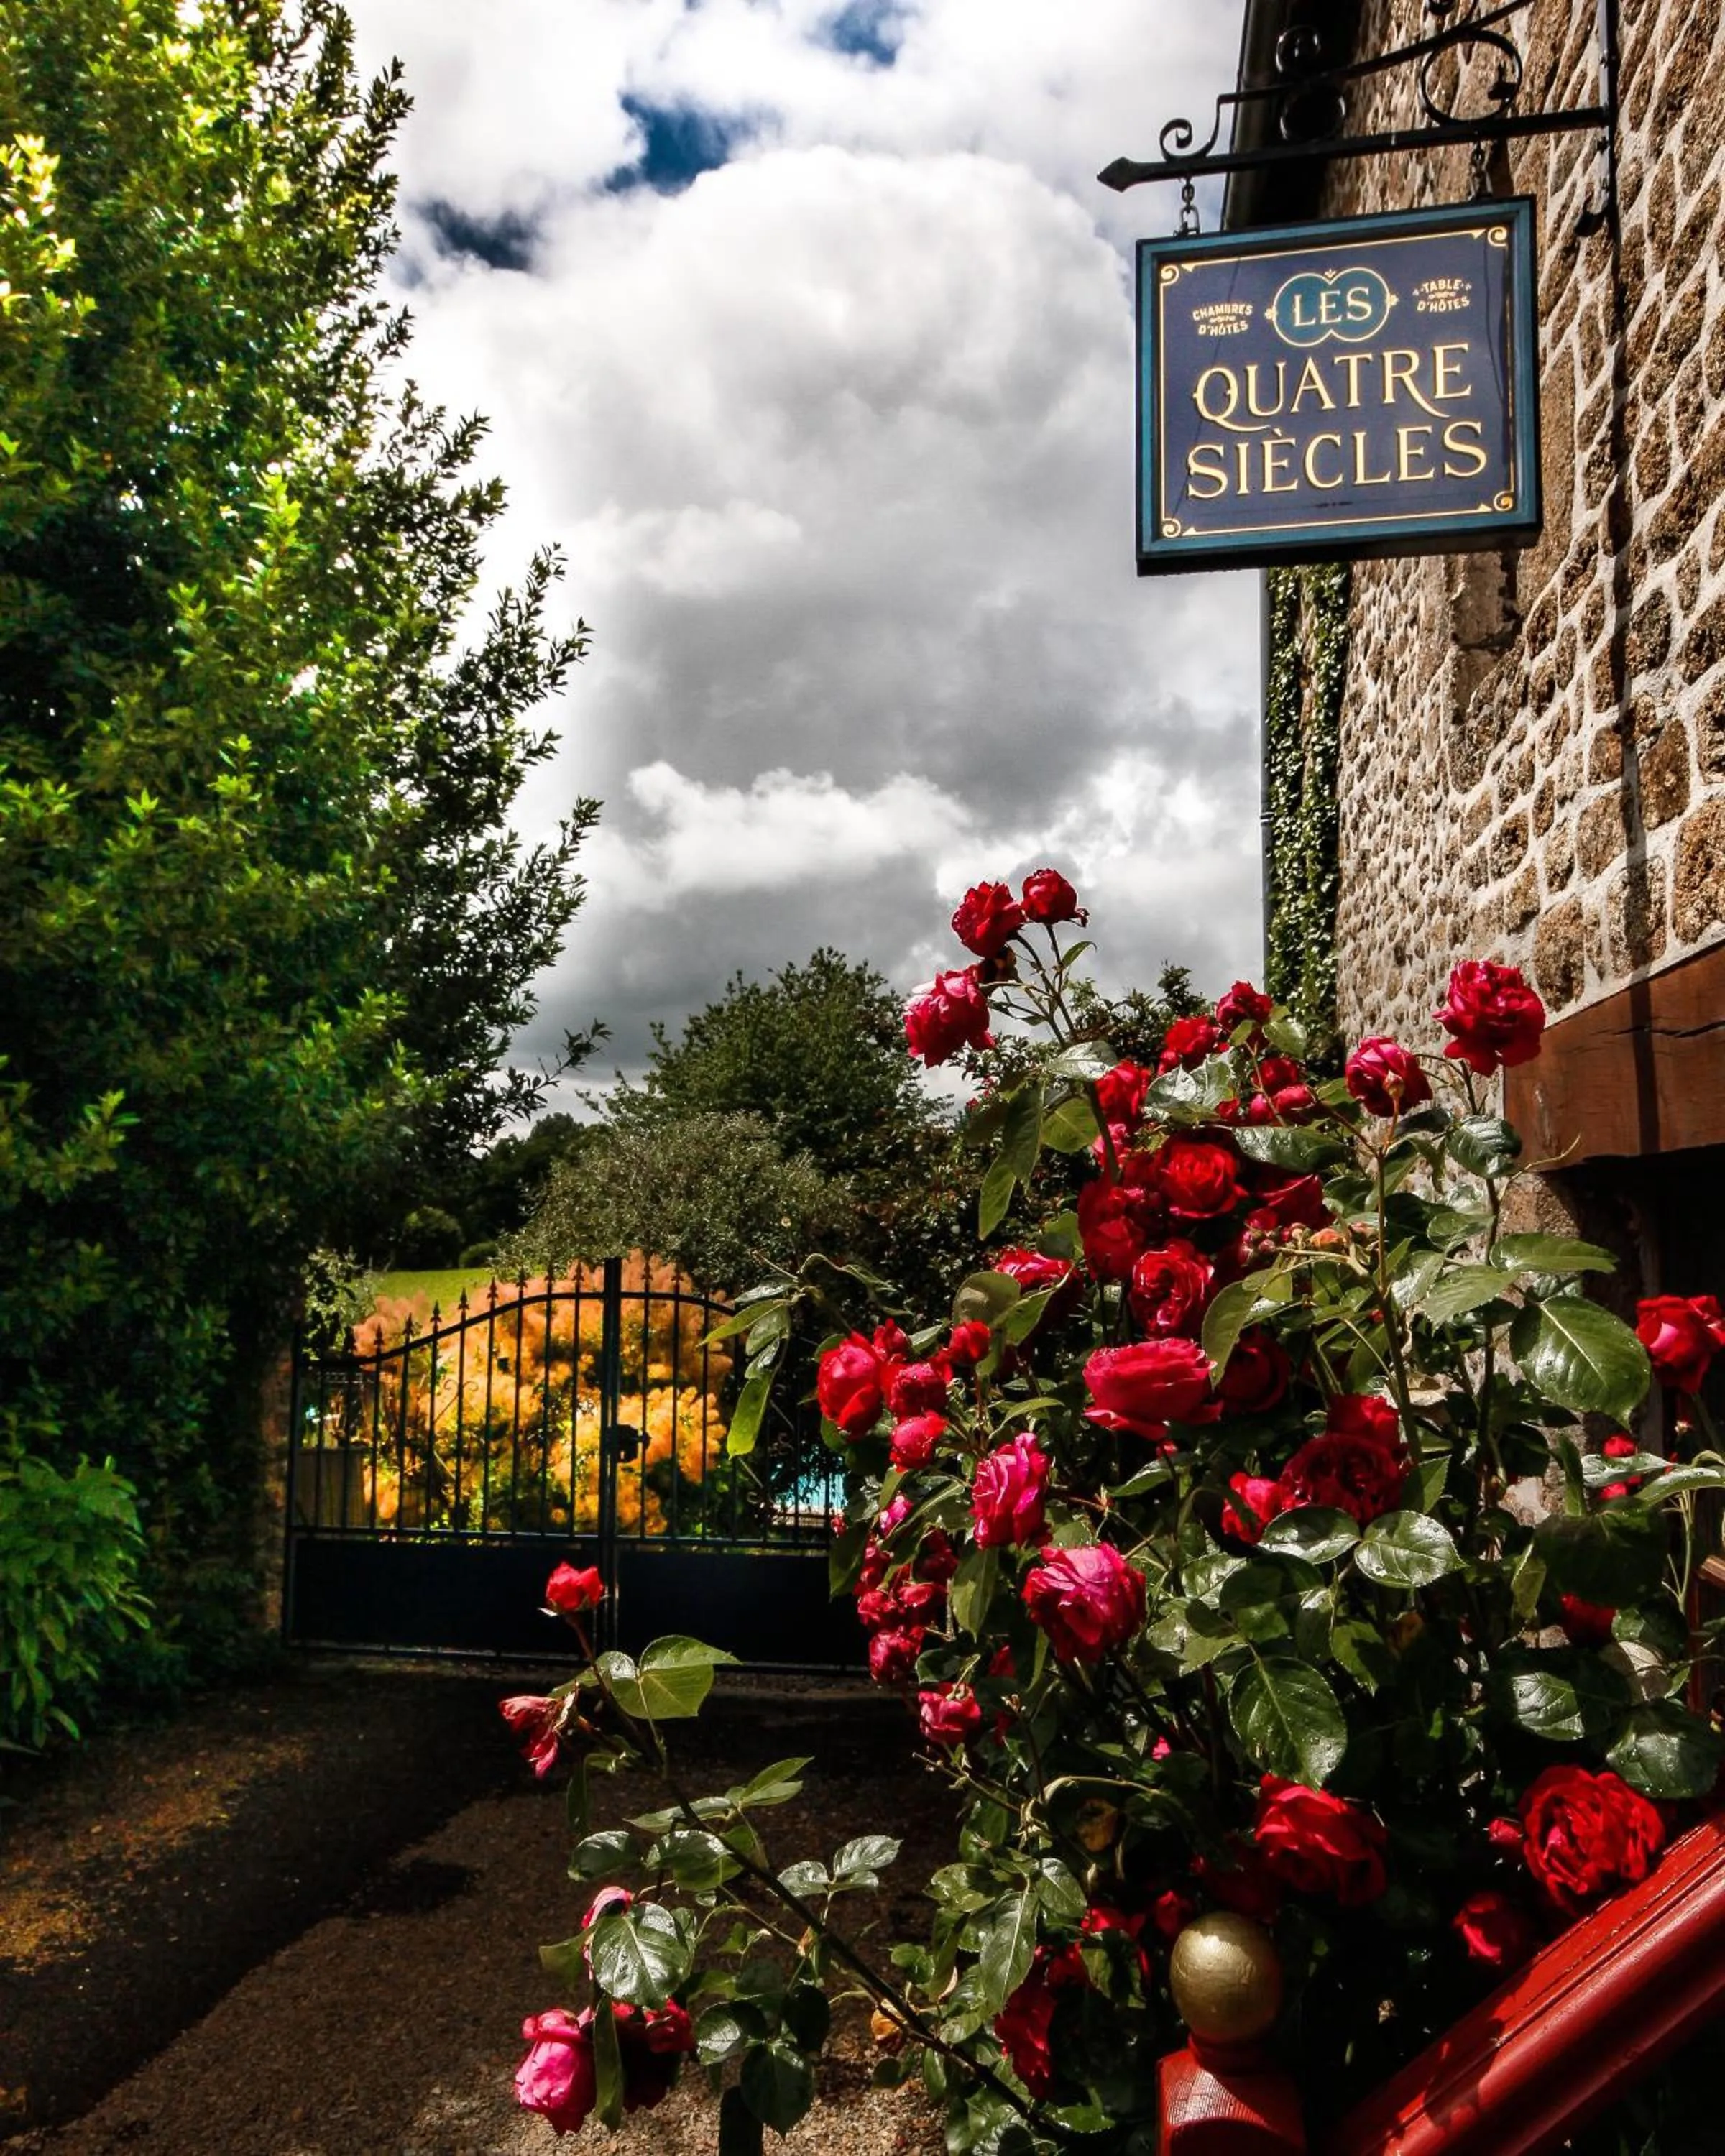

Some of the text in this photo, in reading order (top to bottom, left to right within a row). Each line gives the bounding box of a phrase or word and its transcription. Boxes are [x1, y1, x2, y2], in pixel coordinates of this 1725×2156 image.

[1422, 278, 1462, 293] TABLE
[1192, 303, 1254, 321] CHAMBRES
[1294, 287, 1372, 327] LES
[1417, 295, 1470, 313] D'HÔTES
[1198, 320, 1248, 336] D'HÔTES
[1192, 343, 1472, 432] QUATRE
[1187, 420, 1488, 499] SIÈCLES
